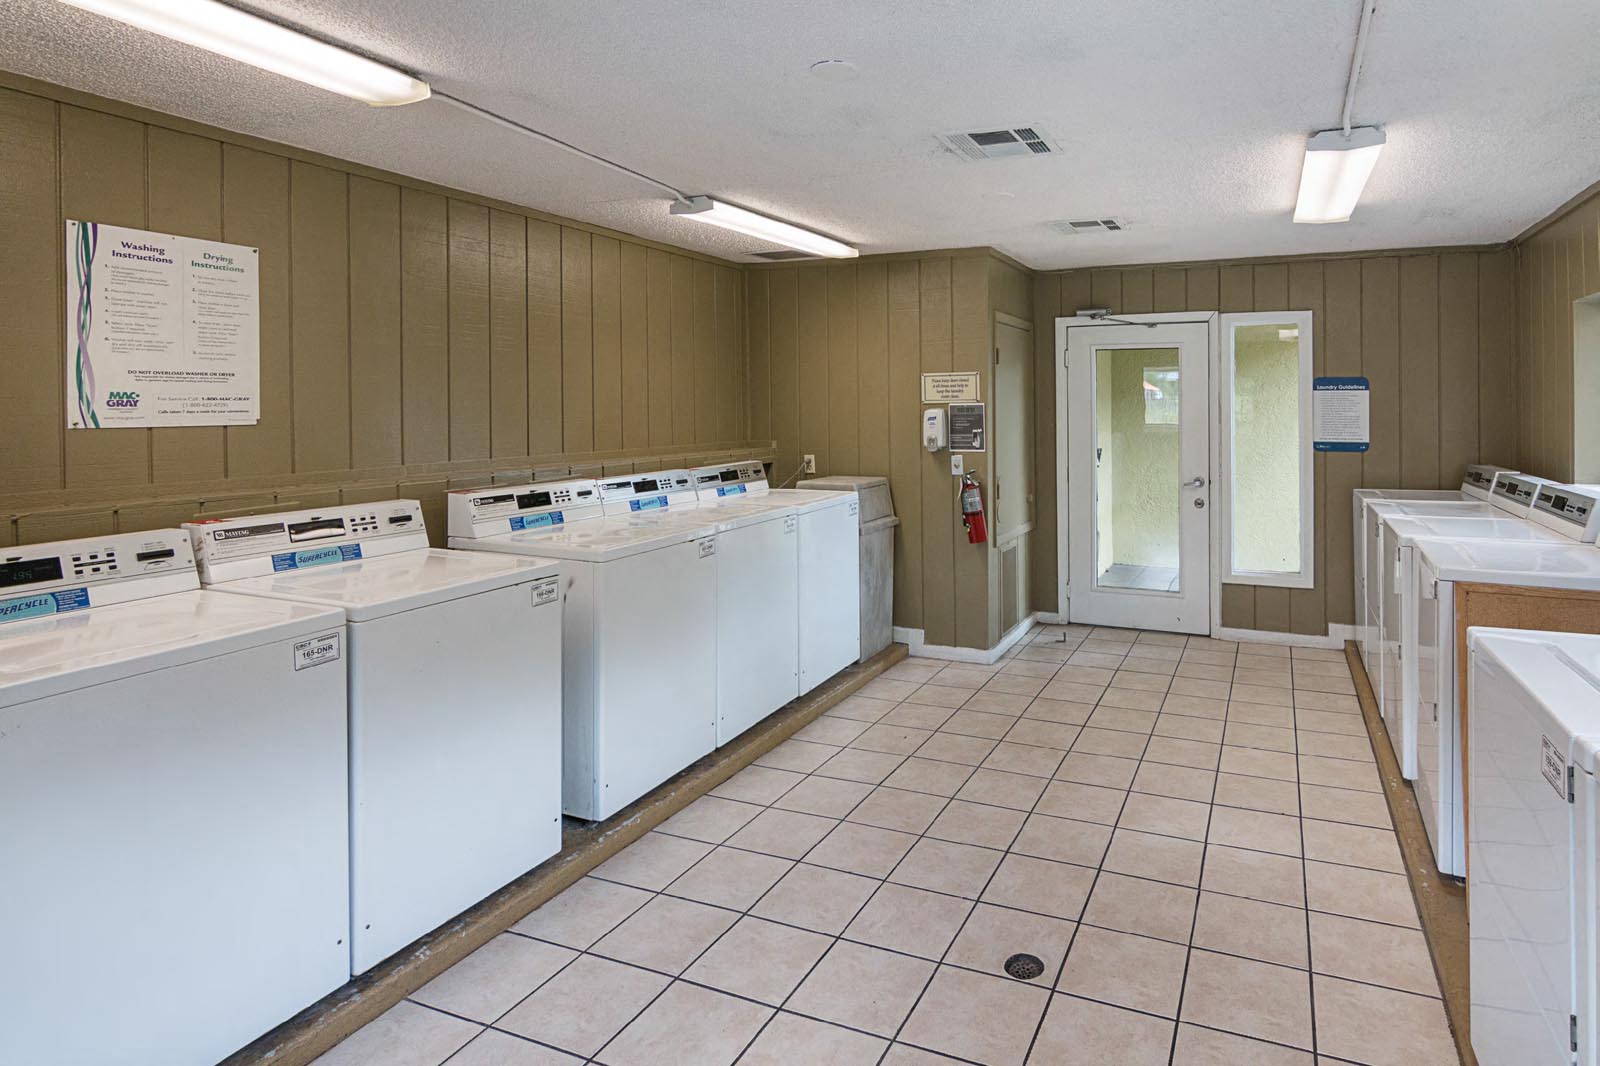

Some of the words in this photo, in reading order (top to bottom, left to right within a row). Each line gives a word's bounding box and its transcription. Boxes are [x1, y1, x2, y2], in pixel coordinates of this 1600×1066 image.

[121, 241, 165, 256] Washing
[112, 250, 173, 264] Instructions
[203, 252, 234, 265] Drying
[191, 260, 245, 273] Instructions
[106, 399, 140, 408] GRAY
[225, 529, 250, 537] MAYTAG
[298, 549, 338, 563] SUPERCYCLE
[302, 644, 334, 659] 165-DNR
